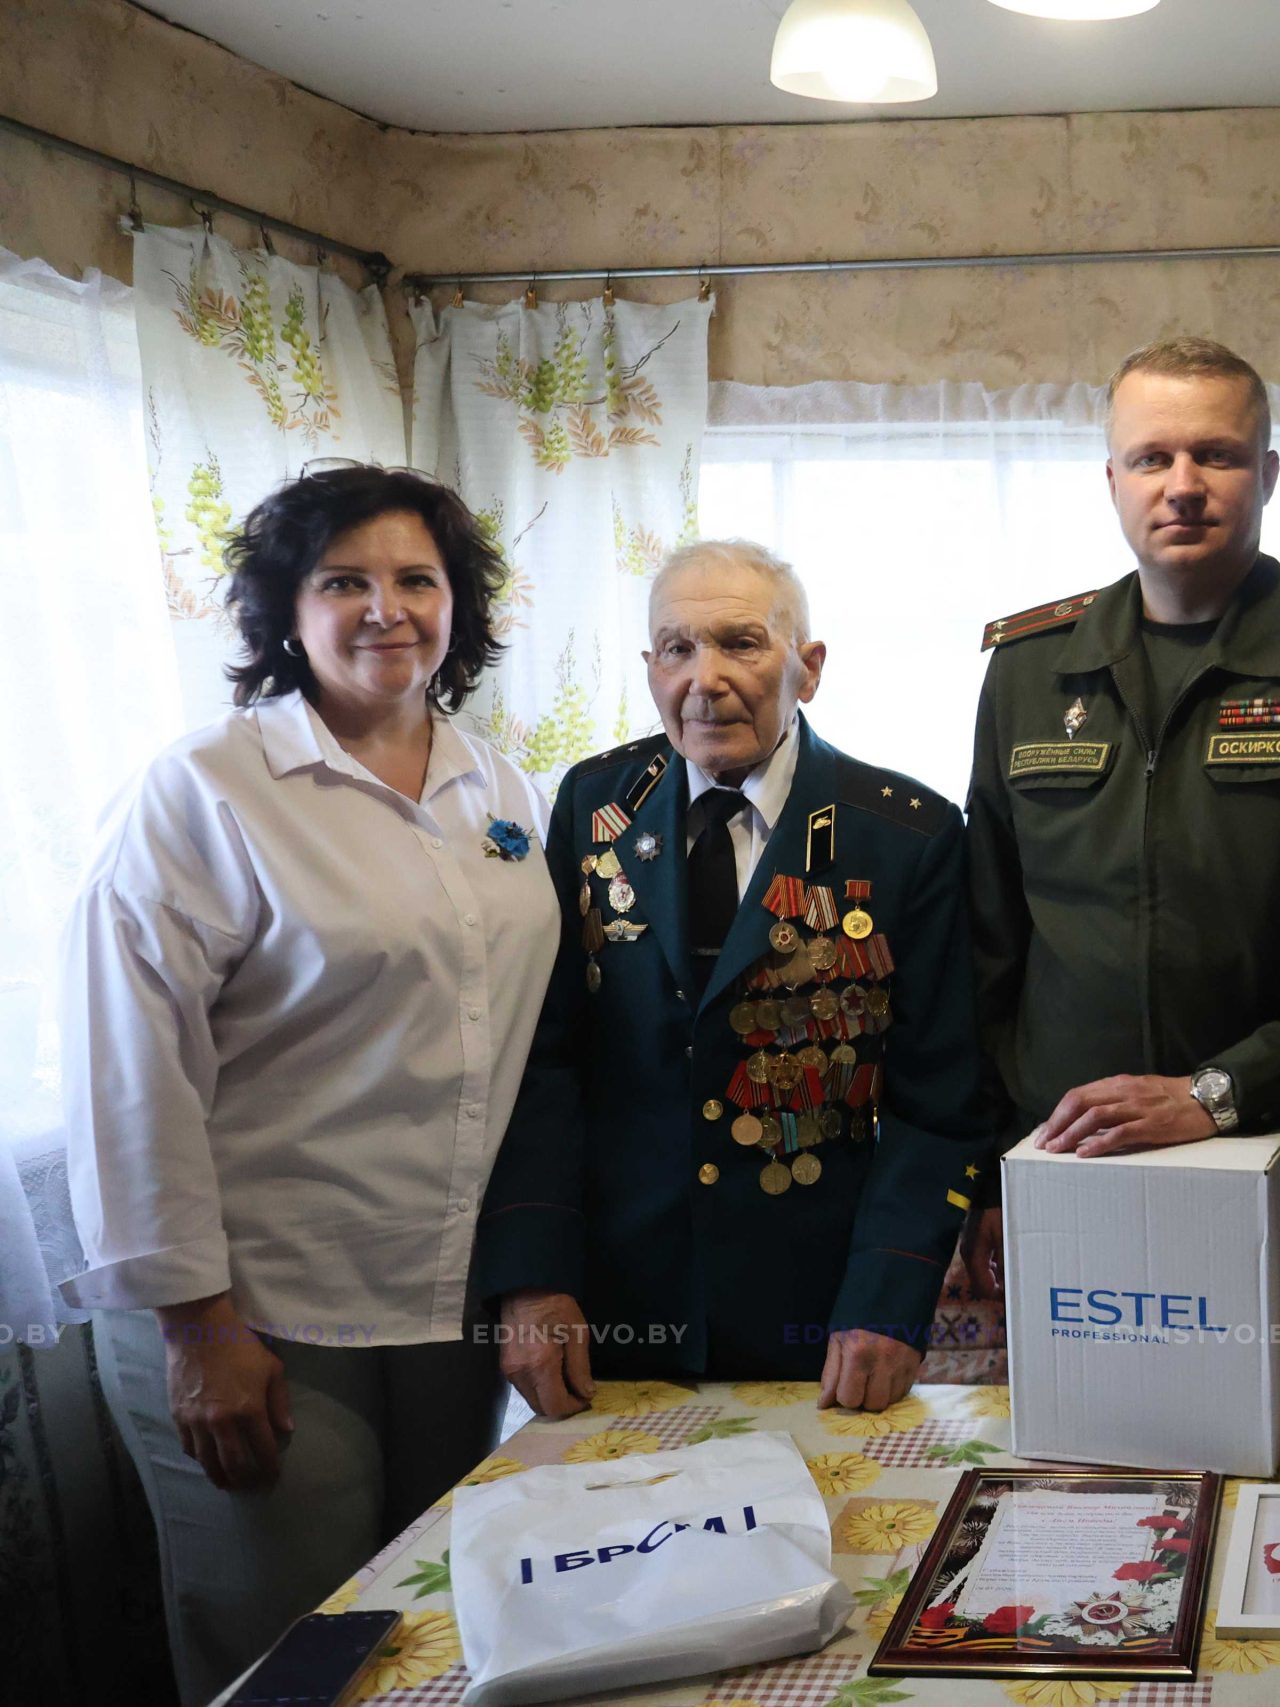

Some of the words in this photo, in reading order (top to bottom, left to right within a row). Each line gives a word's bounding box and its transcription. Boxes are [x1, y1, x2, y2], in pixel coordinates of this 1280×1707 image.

[1058, 756, 1099, 765] БЕЛАРУСЬ
[1050, 1287, 1229, 1333] ESTEL
[1052, 1328, 1170, 1345] PROFESSIONAL
